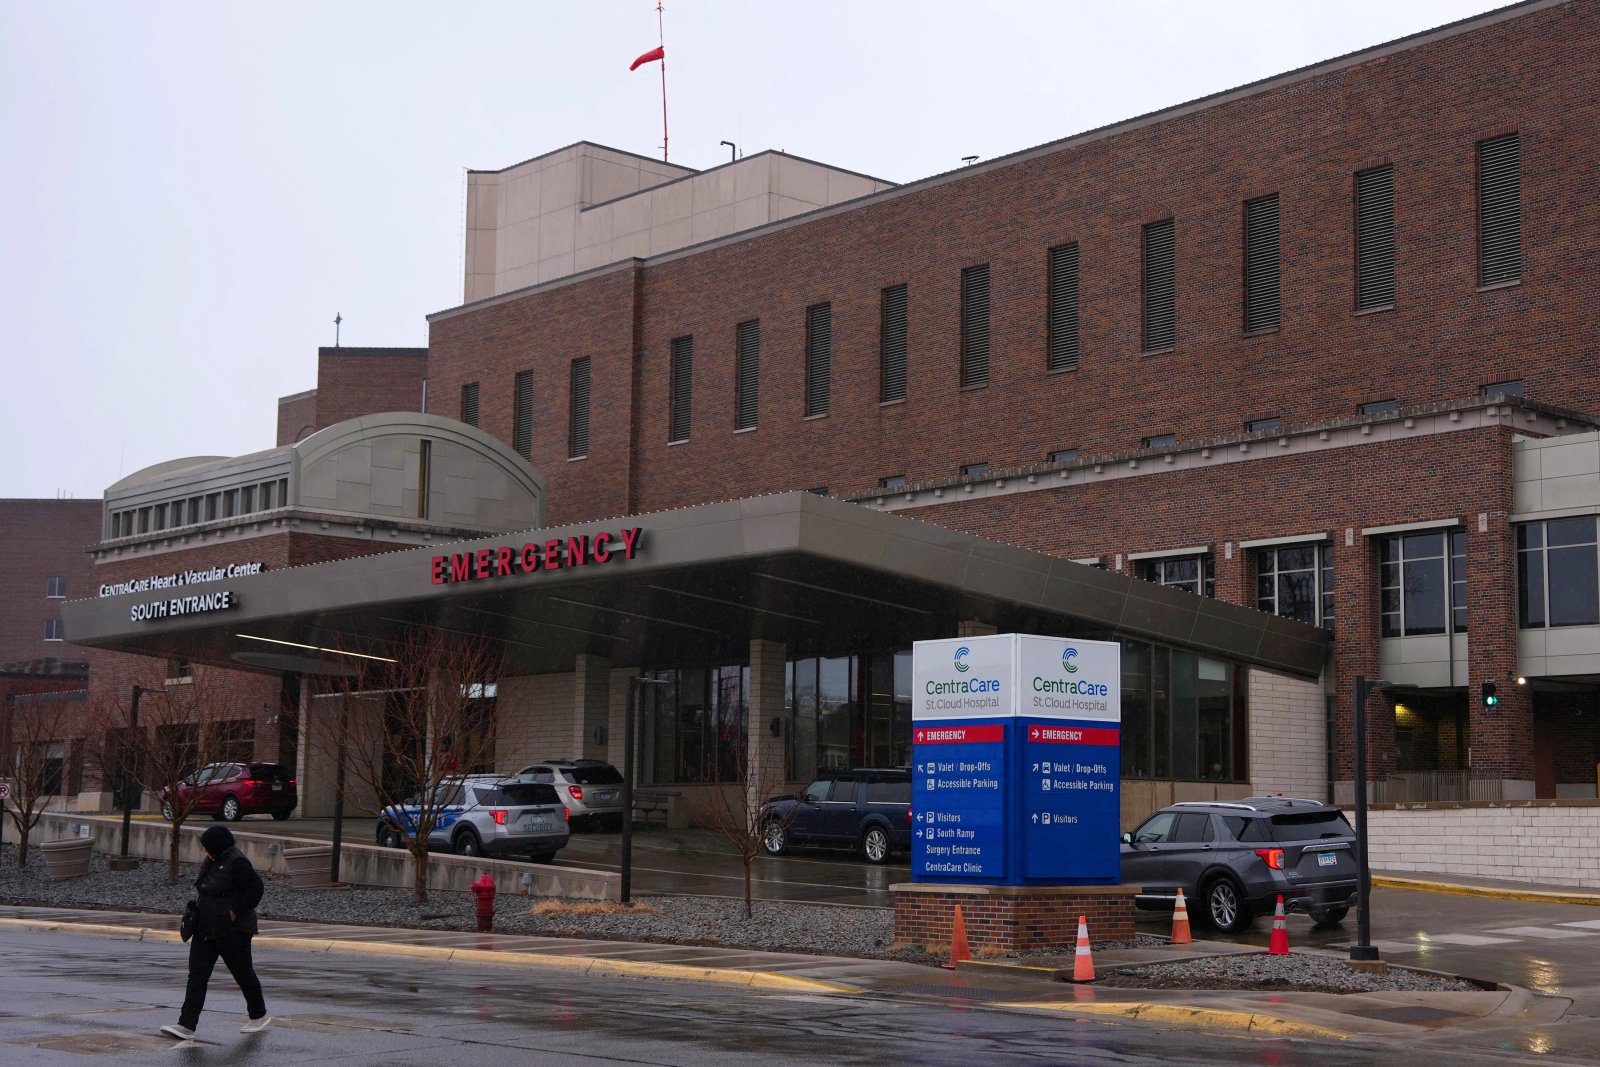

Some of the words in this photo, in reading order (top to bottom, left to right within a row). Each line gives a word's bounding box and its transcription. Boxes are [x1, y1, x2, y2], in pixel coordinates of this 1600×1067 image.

[431, 527, 642, 585] EMERGENCY
[150, 574, 176, 590] Heart
[177, 575, 185, 586] &
[185, 567, 226, 584] Vascular
[227, 562, 261, 579] Center
[131, 602, 167, 621] SOUTH
[170, 592, 229, 616] ENTRANCE
[926, 678, 1000, 695] CentraCare
[1033, 677, 1107, 696] CentraCare
[937, 698, 962, 709] Cloud
[963, 697, 999, 709] Hospital
[1045, 697, 1070, 709] Cloud
[1073, 699, 1107, 711] Hospital
[926, 730, 966, 740] EMERGENCY
[1042, 729, 1083, 740] EMERGENCY
[937, 763, 954, 772] Valet
[959, 762, 991, 772] Drop-Offs
[1053, 763, 1070, 773] Valet
[1076, 764, 1107, 774] Drop-Offs
[937, 779, 972, 788] Accessible
[973, 779, 998, 789] Parking
[1053, 780, 1088, 790] Accessible
[1089, 781, 1114, 792] Parking
[937, 813, 961, 823] Visitors
[1053, 814, 1078, 824] Visitors
[523, 823, 553, 832] SECURITY
[937, 829, 954, 838] South
[956, 829, 975, 839] Ramp
[926, 845, 950, 856] Surgery
[952, 846, 981, 855] Entrance
[925, 862, 962, 872] CentraCare
[963, 862, 982, 873] Clinic
